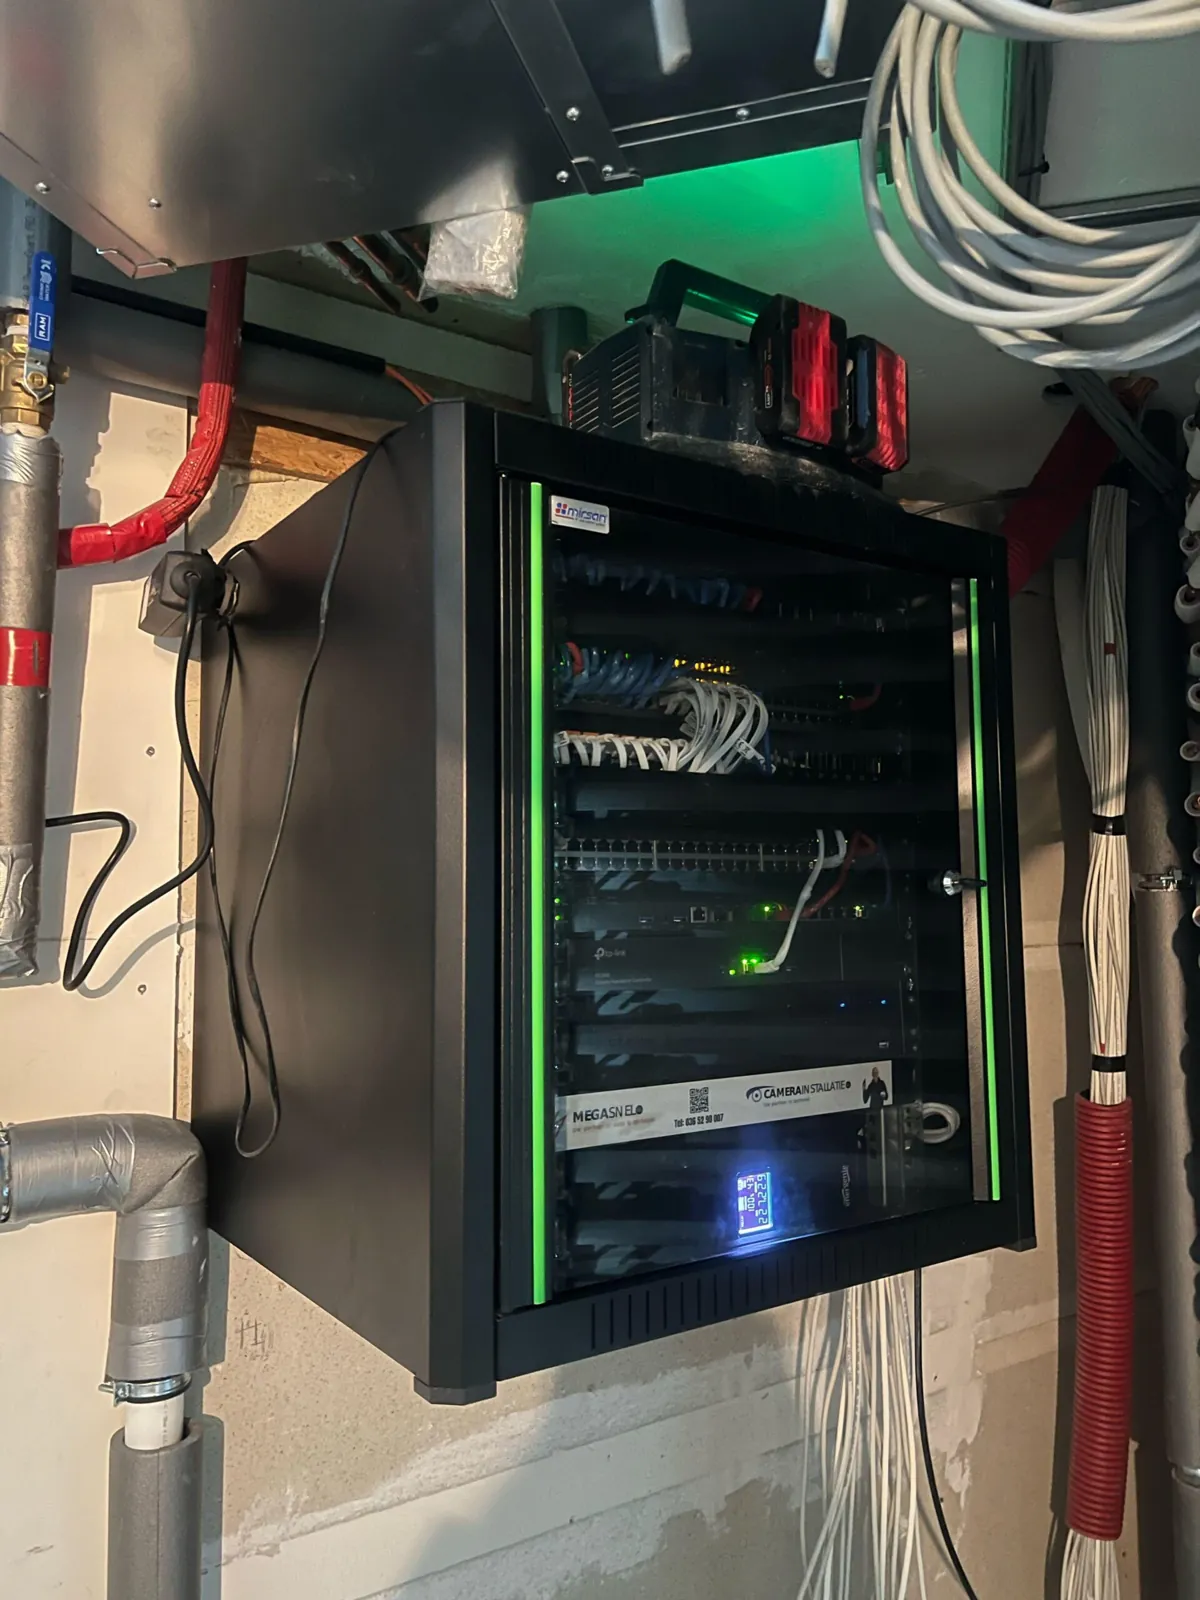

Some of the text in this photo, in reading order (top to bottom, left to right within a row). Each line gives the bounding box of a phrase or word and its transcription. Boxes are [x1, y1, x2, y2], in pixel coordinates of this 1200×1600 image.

[38, 316, 47, 338] RAM
[567, 507, 607, 524] mirsan
[763, 1080, 846, 1100] CAMERAINSTALLATIE
[697, 1115, 704, 1125] 52
[705, 1113, 713, 1124] 90
